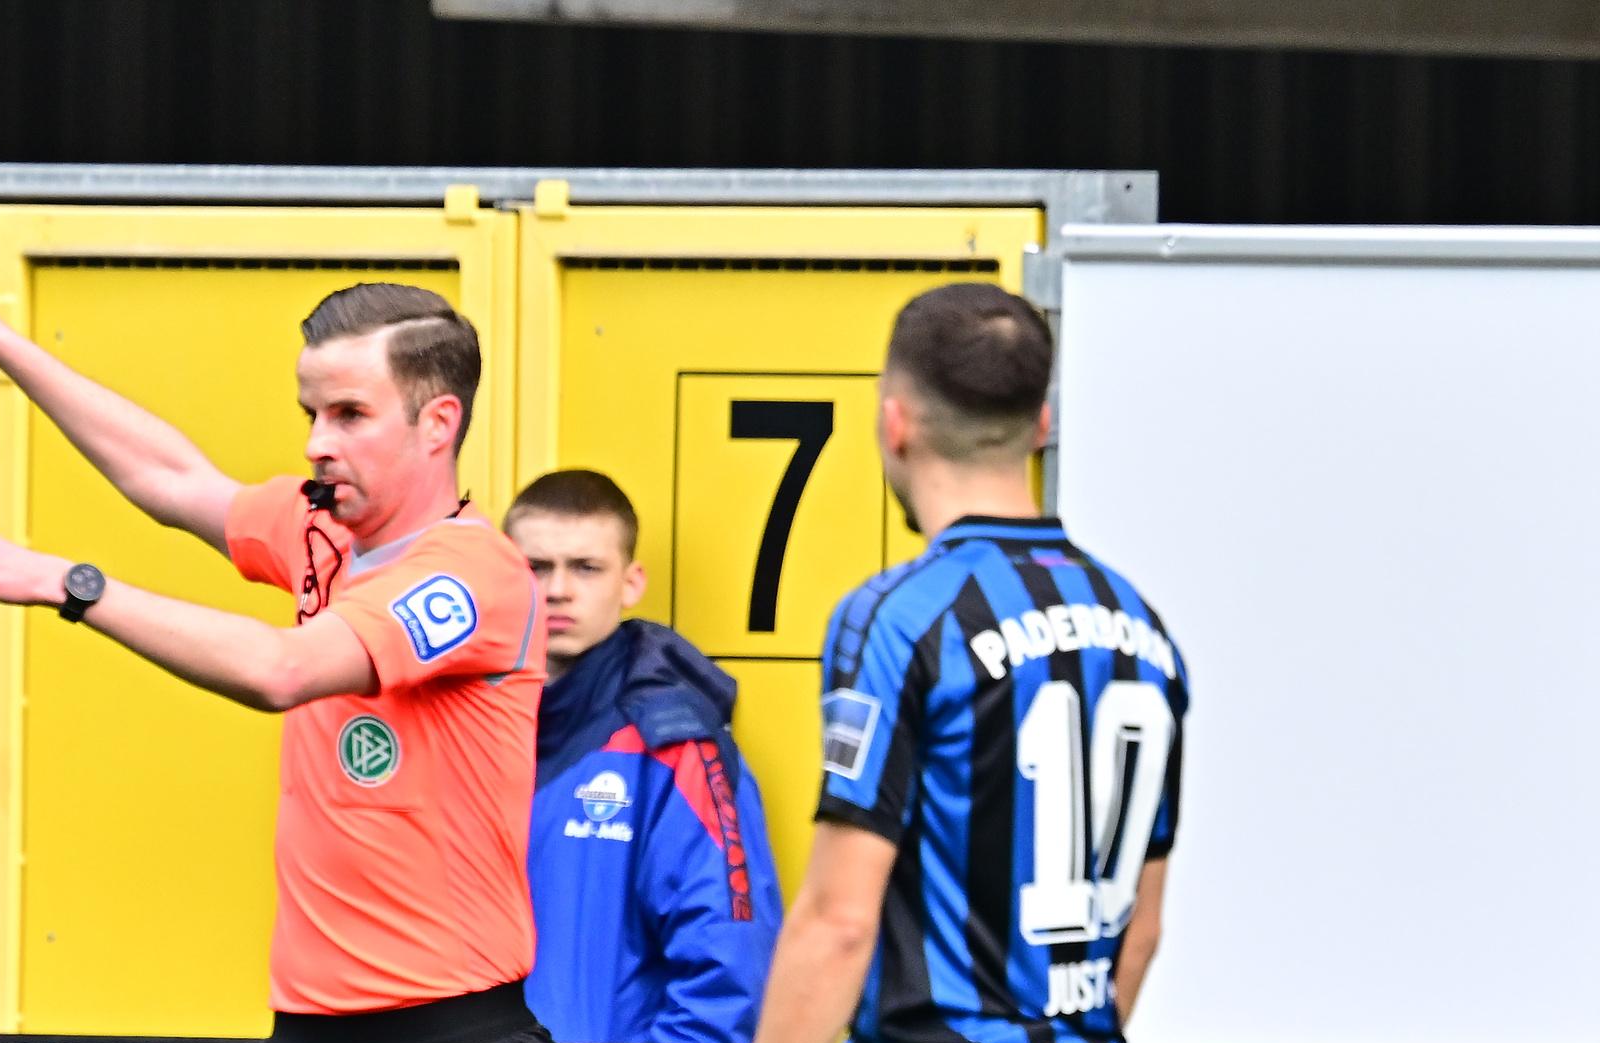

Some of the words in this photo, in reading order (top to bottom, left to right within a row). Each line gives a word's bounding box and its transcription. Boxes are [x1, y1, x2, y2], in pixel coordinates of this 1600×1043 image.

[729, 400, 834, 633] 7
[969, 603, 1177, 681] PADERBORN
[1016, 680, 1175, 946] 10
